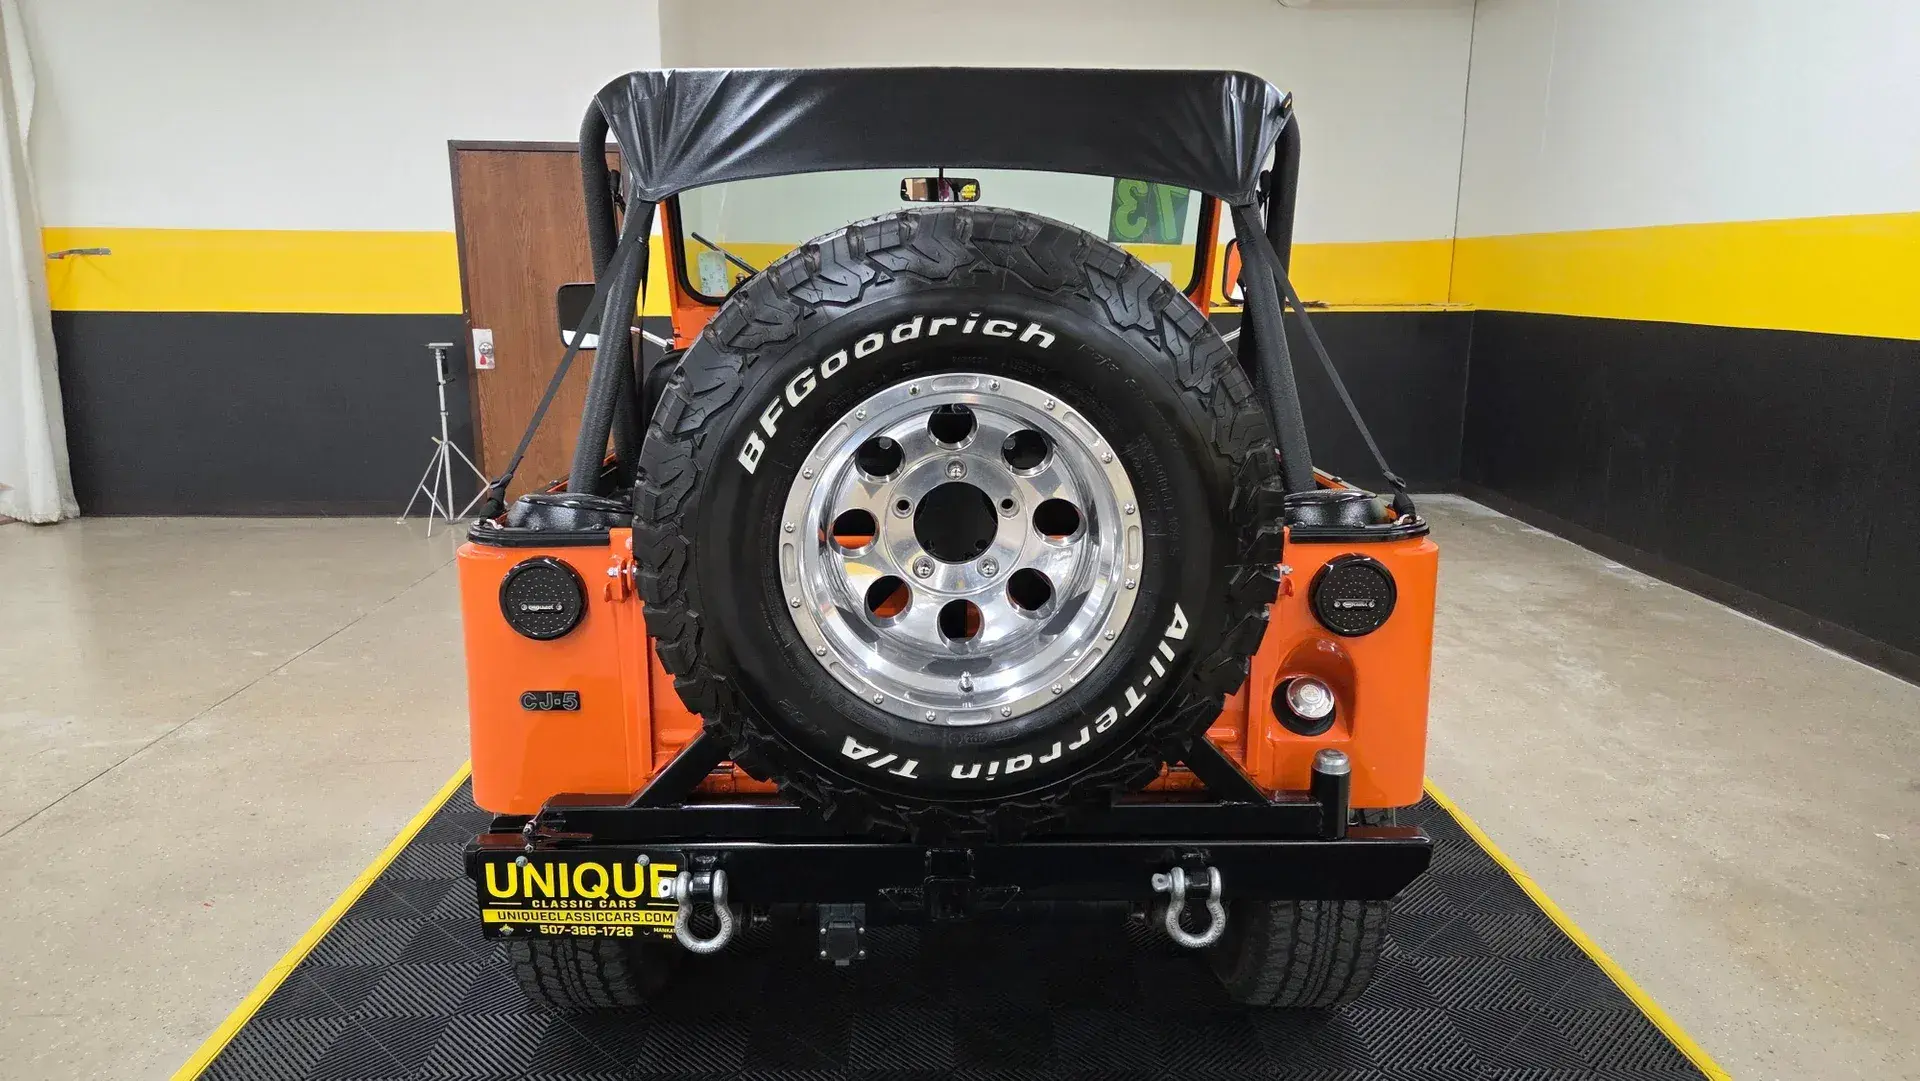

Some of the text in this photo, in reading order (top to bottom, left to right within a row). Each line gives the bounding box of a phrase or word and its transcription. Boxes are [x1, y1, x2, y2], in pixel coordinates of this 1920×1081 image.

[737, 311, 1057, 475] BFGoodrich
[950, 601, 1189, 781] All-Terrain
[840, 735, 920, 780] T/A
[484, 861, 677, 900] UNIQUE
[497, 911, 674, 923] UNIQUECLASSICCARS.COM
[531, 899, 637, 909] CLASSIC CARS
[539, 924, 634, 937] 507-386-1726
